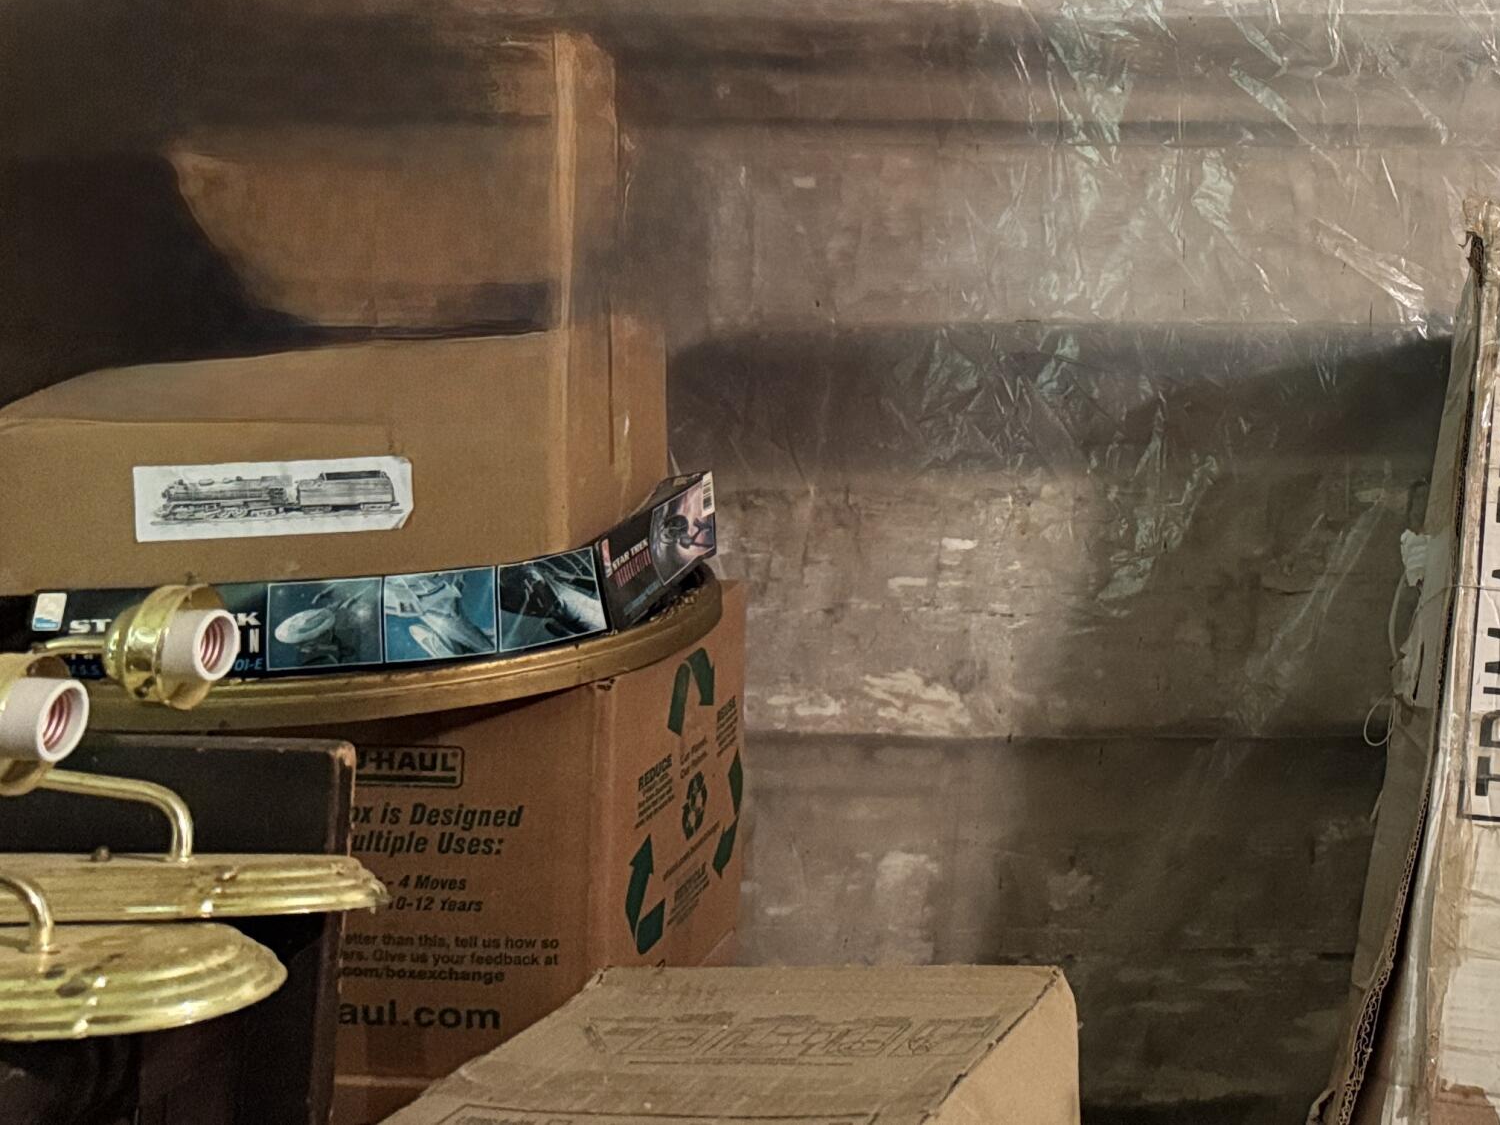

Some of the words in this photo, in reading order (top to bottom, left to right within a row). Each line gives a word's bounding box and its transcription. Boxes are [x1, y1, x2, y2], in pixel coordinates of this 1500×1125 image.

[68, 618, 112, 635] ST
[380, 802, 402, 825] is
[410, 803, 524, 831] Designed
[352, 830, 428, 858] ultiple
[438, 832, 504, 855] Uses:
[399, 874, 410, 889] 4
[414, 874, 466, 891] Moves
[440, 897, 483, 912] Years
[345, 934, 377, 946] etter
[382, 933, 414, 946] than
[455, 935, 477, 948] tell
[482, 938, 500, 948] us
[505, 936, 536, 949] how
[541, 939, 559, 949] so
[372, 949, 407, 962] Give
[411, 952, 428, 963] us
[432, 953, 465, 966] your
[470, 952, 538, 966] feedback
[544, 954, 558, 965] at
[339, 965, 505, 985] .com/boxexchange
[338, 999, 501, 1029] aul.com
